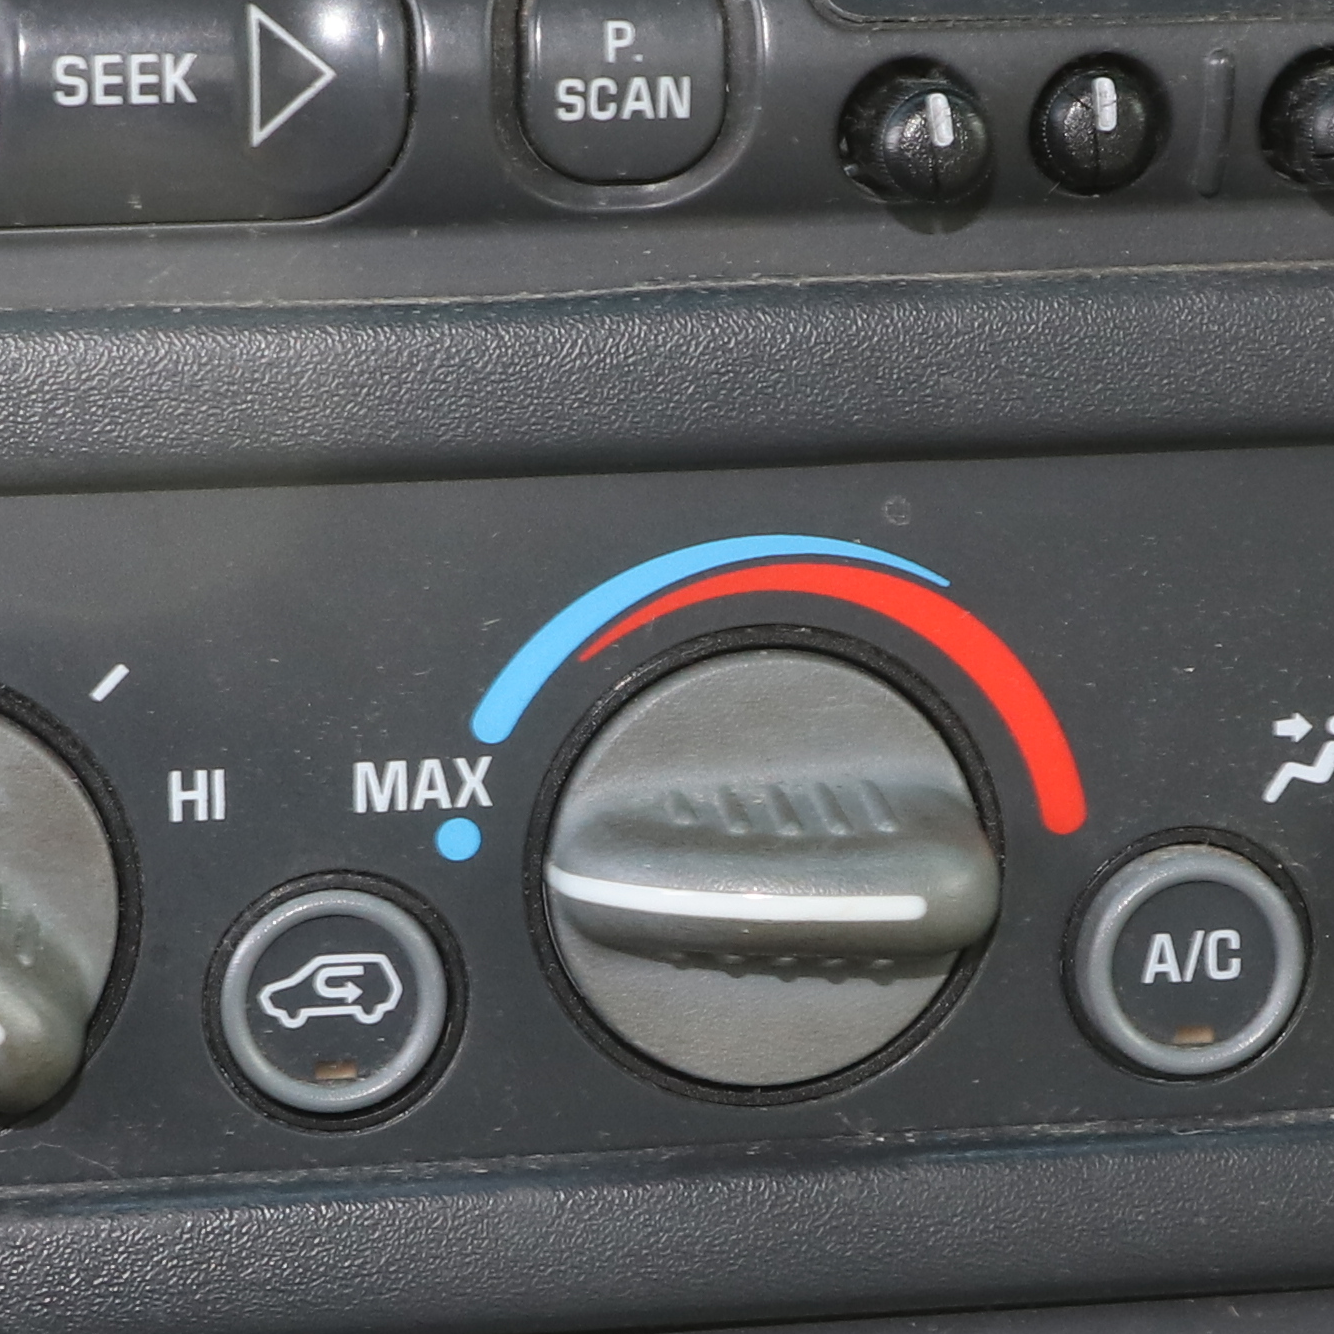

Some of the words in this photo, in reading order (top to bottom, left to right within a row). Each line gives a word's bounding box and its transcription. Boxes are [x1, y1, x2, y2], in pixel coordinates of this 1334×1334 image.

[602, 20, 642, 62] P.
[53, 52, 196, 107] SEEK
[555, 77, 692, 123] SCAN
[168, 769, 226, 822] HI
[352, 757, 493, 814] MAX
[1141, 928, 1243, 986] A/C
